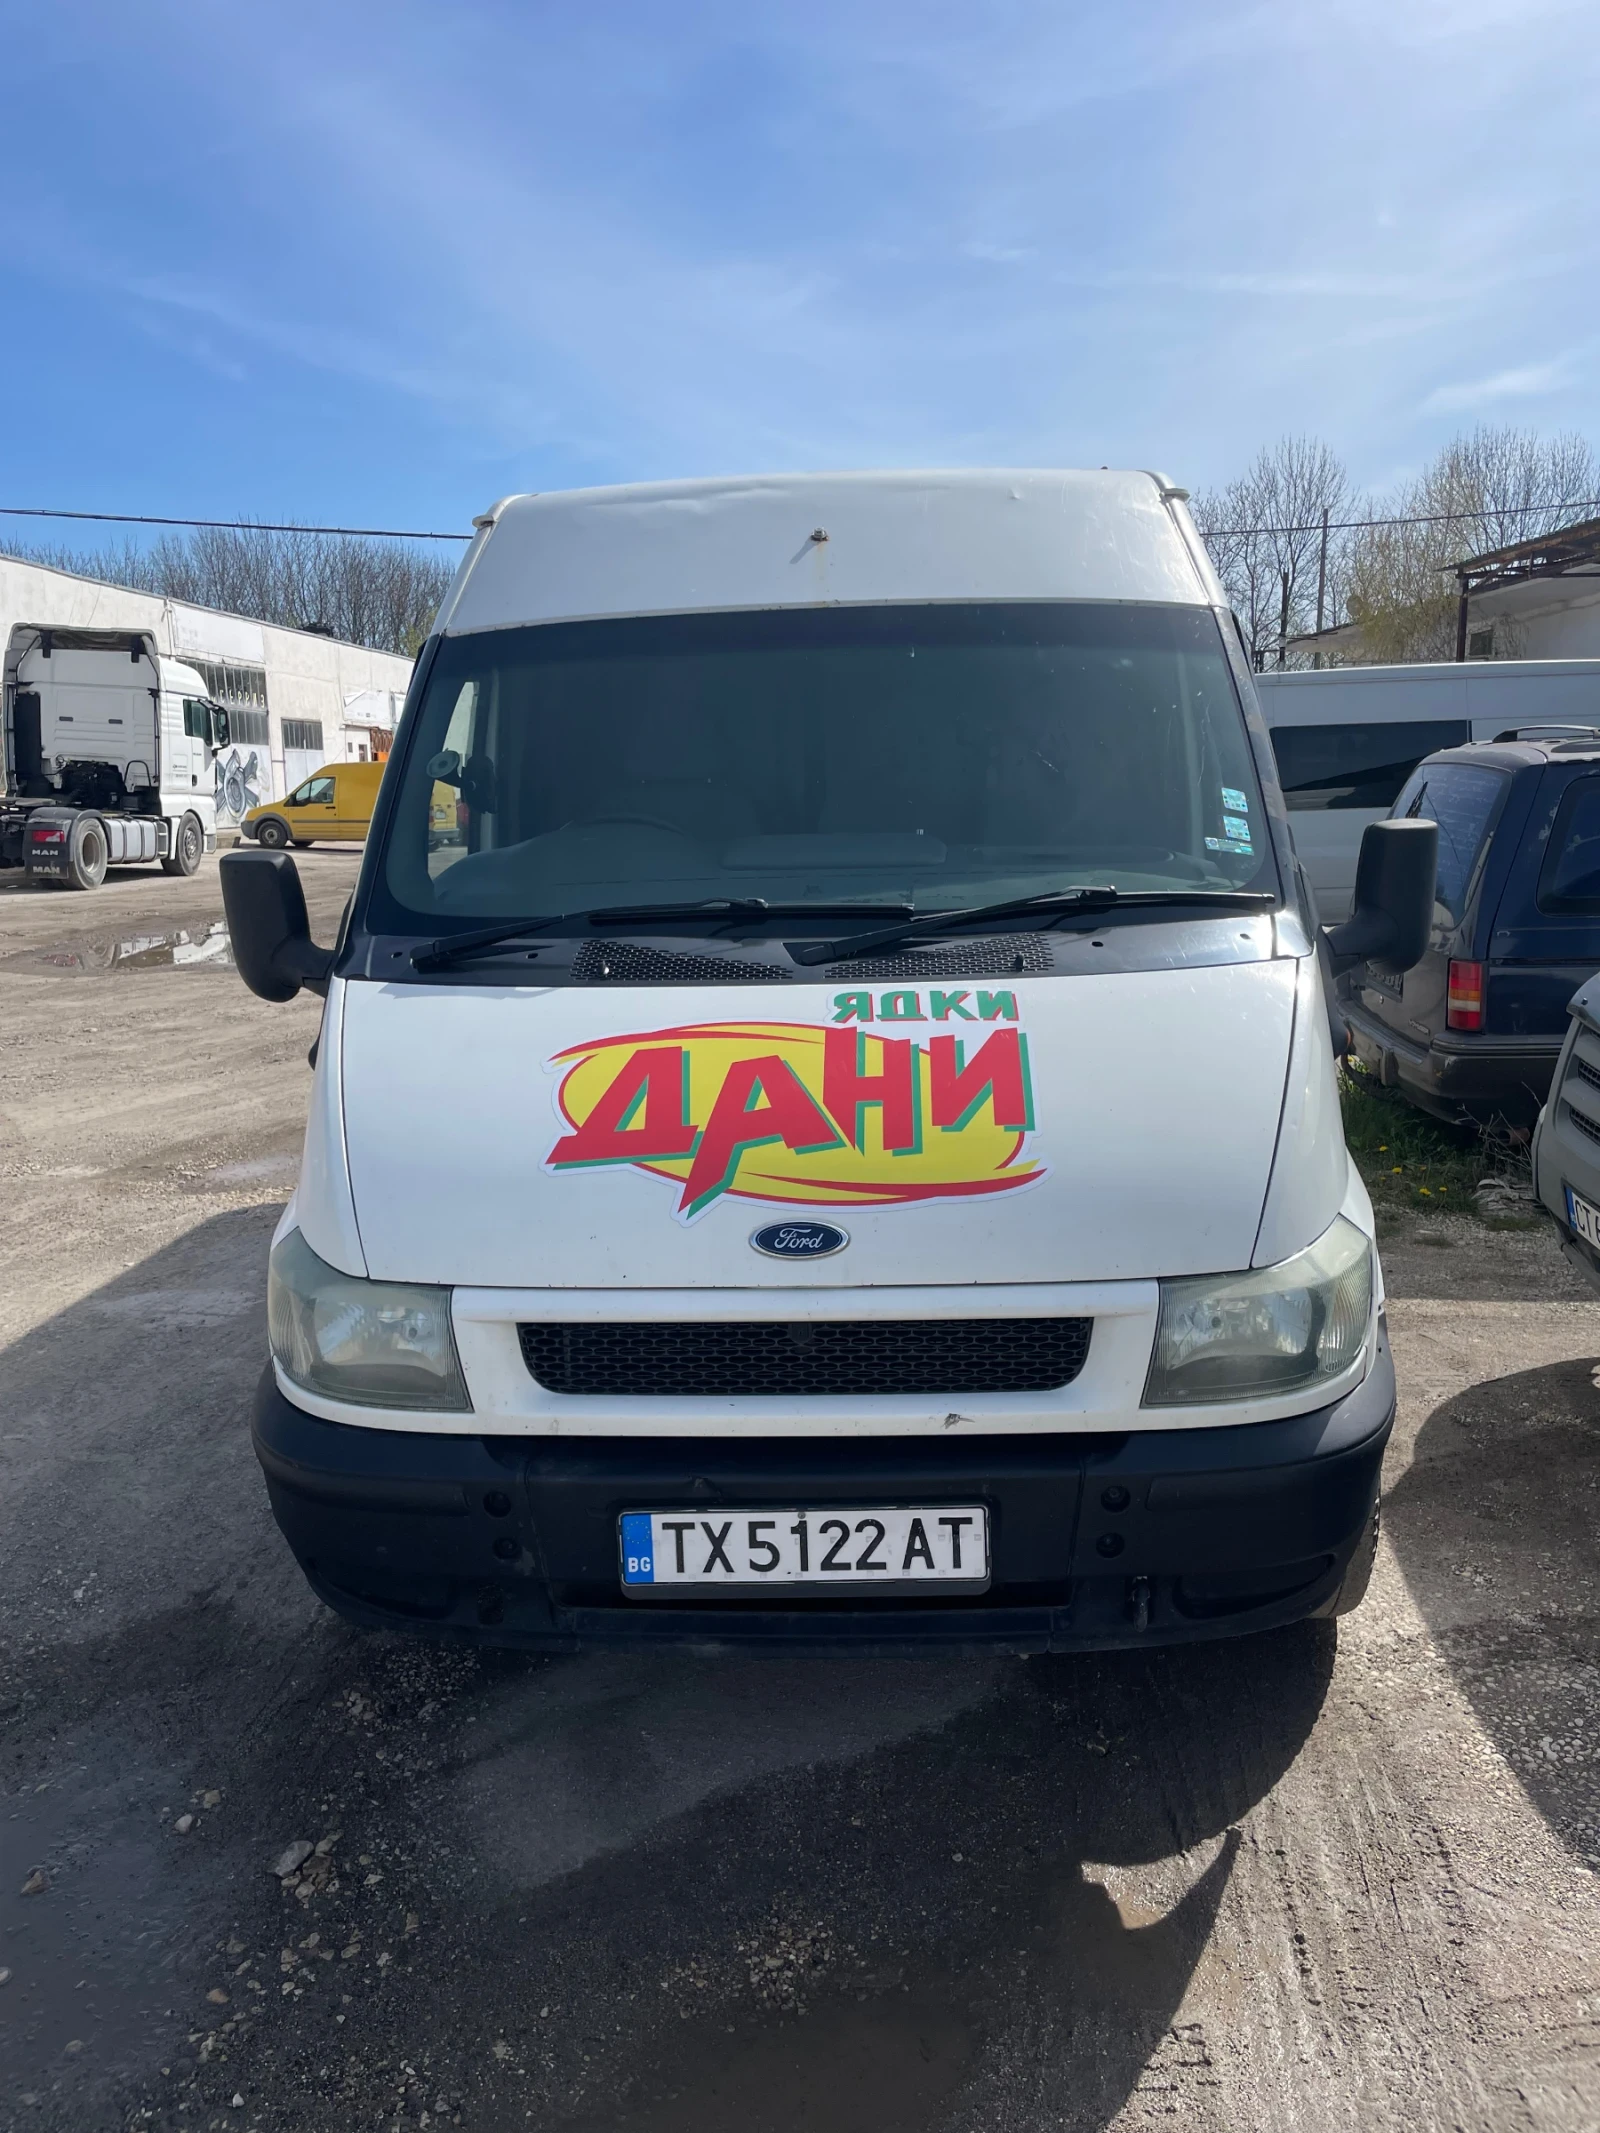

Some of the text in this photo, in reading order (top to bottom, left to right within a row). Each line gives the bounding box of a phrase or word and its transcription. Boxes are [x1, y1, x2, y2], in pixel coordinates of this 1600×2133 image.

[32, 866, 60, 874] MAN
[831, 990, 1020, 1023] ЯДКИ
[545, 1026, 1036, 1221] ДАНИ
[774, 1227, 824, 1249] Ford
[627, 1556, 652, 1574] BG
